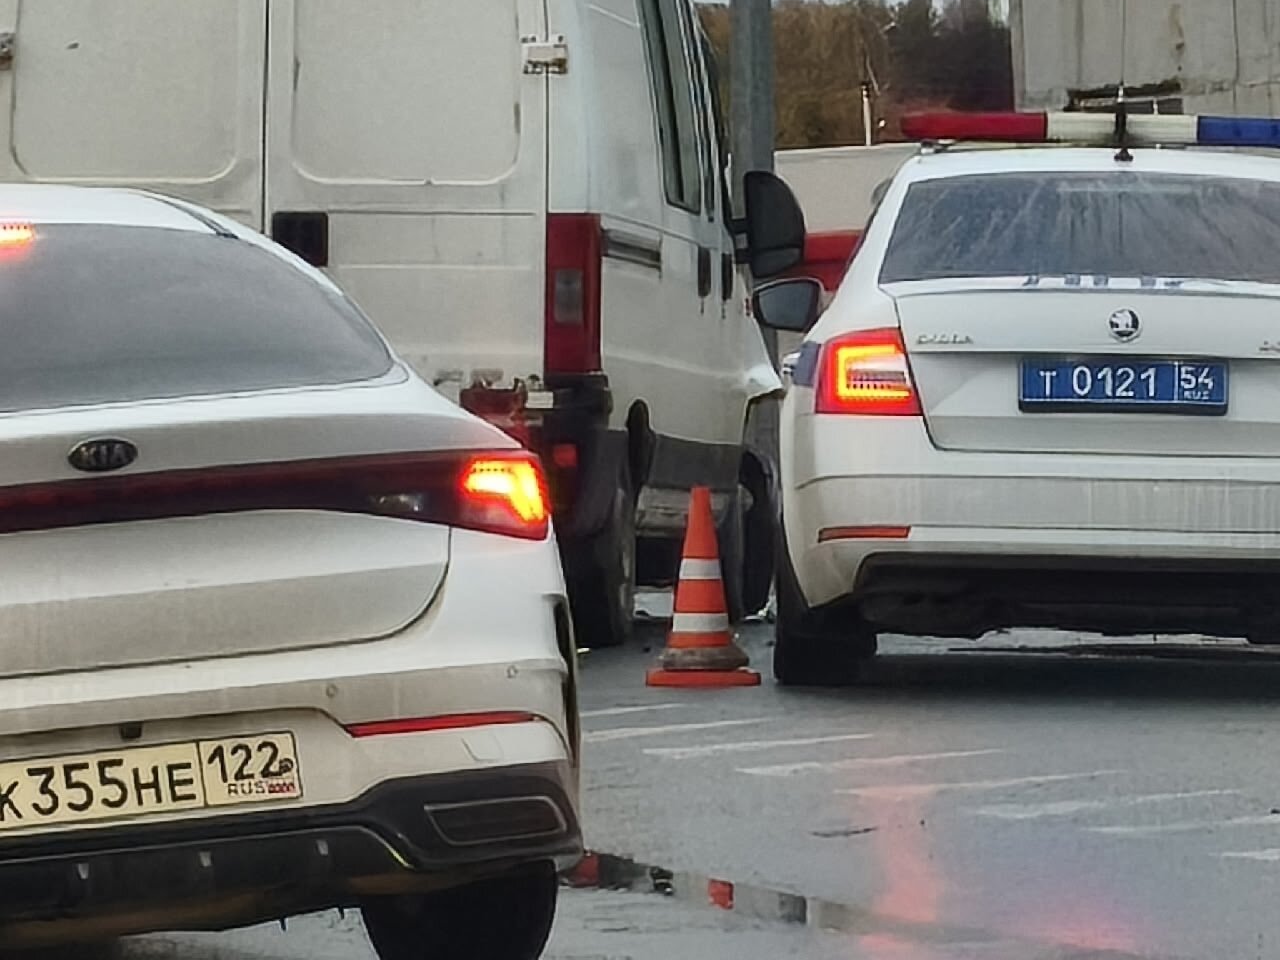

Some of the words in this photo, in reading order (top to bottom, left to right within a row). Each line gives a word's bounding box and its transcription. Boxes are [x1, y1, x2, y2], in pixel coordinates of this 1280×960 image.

[1072, 365, 1156, 397] 0121
[1180, 366, 1214, 390] 54
[207, 741, 279, 784] 122
[227, 781, 266, 795] RUS
